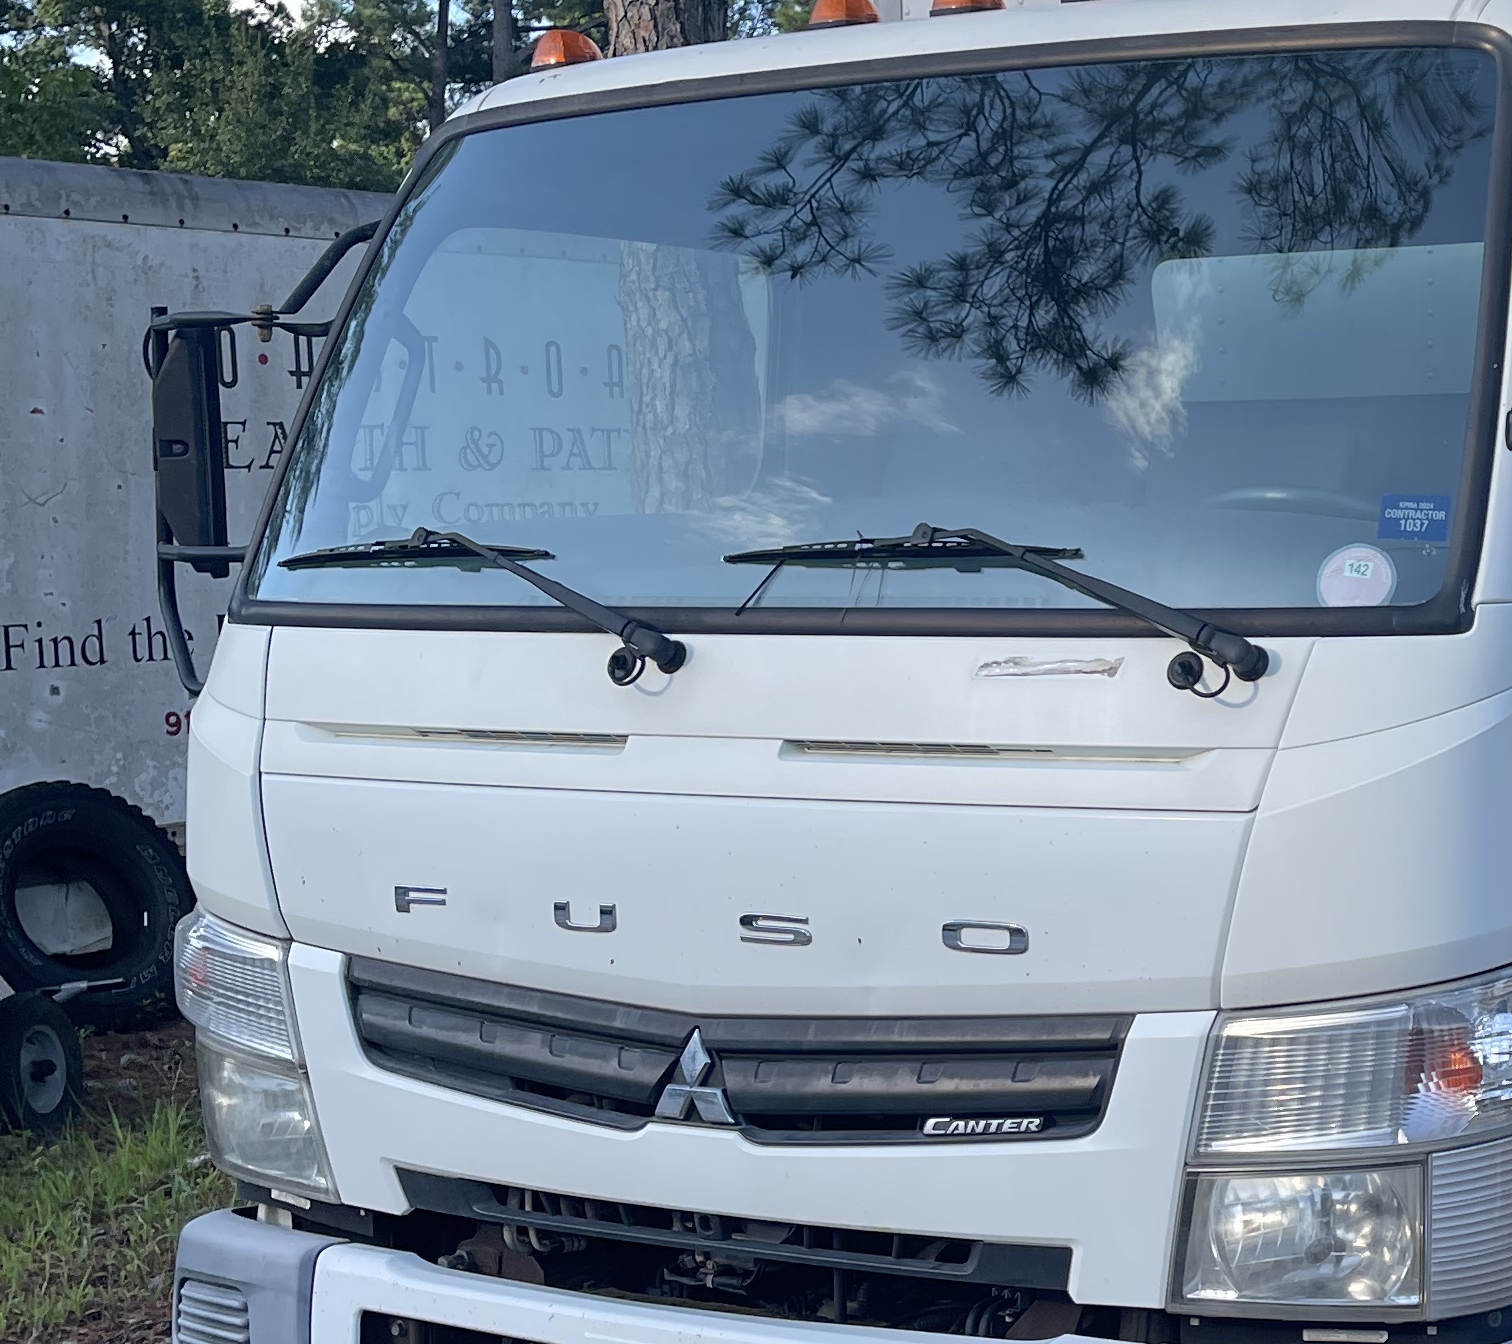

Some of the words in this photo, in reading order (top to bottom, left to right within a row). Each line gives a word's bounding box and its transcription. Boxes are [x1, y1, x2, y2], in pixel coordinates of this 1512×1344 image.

[1384, 508, 1446, 521] CONTRACTOR
[1399, 519, 1429, 532] 1037
[1348, 563, 1370, 577] 142
[0, 618, 108, 671] Find
[394, 885, 1030, 955] FUSO
[923, 1117, 1042, 1135] CANTER
